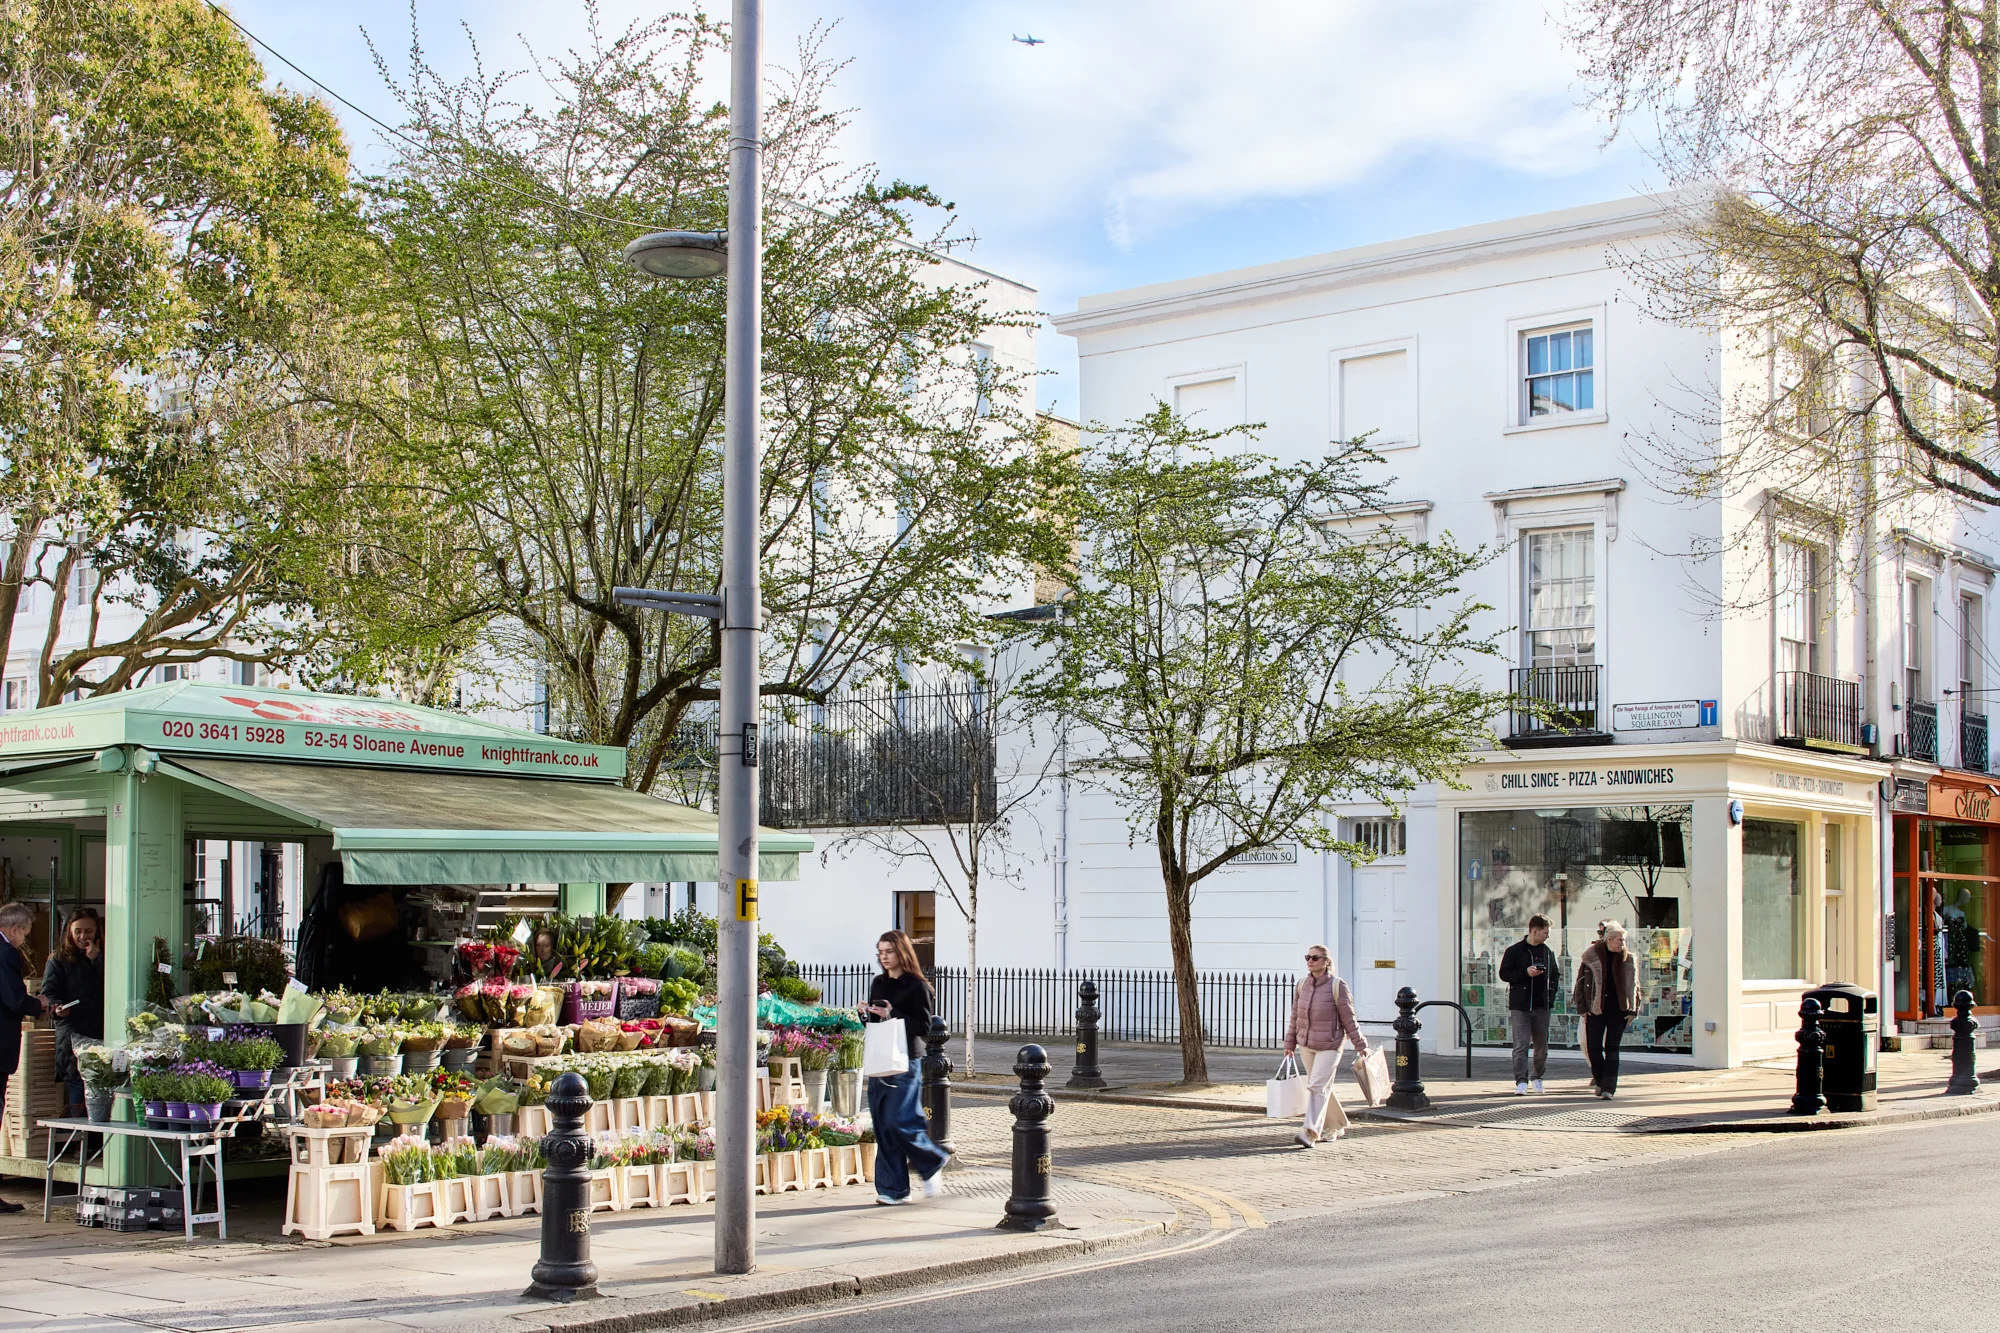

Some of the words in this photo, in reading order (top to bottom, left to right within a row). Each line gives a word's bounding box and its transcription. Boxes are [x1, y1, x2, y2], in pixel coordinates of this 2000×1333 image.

[1630, 711, 1682, 720] WELLINGTON
[162, 721, 194, 738] 020
[199, 723, 238, 741] 3641
[245, 726, 285, 744] 5928
[304, 731, 348, 748] 52-54
[353, 734, 405, 753] Sloane
[410, 739, 464, 758] Avenue
[481, 745, 599, 767] knightfrank.co.uk
[1501, 774, 1529, 789] CHILL
[1530, 772, 1560, 788] SINCE
[1569, 771, 1597, 787] PIZZA
[1607, 768, 1674, 786] SANDWICHES
[1776, 773, 1788, 789] CHILL
[1789, 775, 1800, 791] SINCE
[1804, 777, 1816, 792] PIZZA
[1819, 779, 1844, 797] SANDWICHES
[1955, 789, 1991, 821] Muse
[1231, 851, 1278, 862] WELLINGTON
[1280, 852, 1294, 861] SQ.
[580, 1001, 613, 1012] MEIJER
